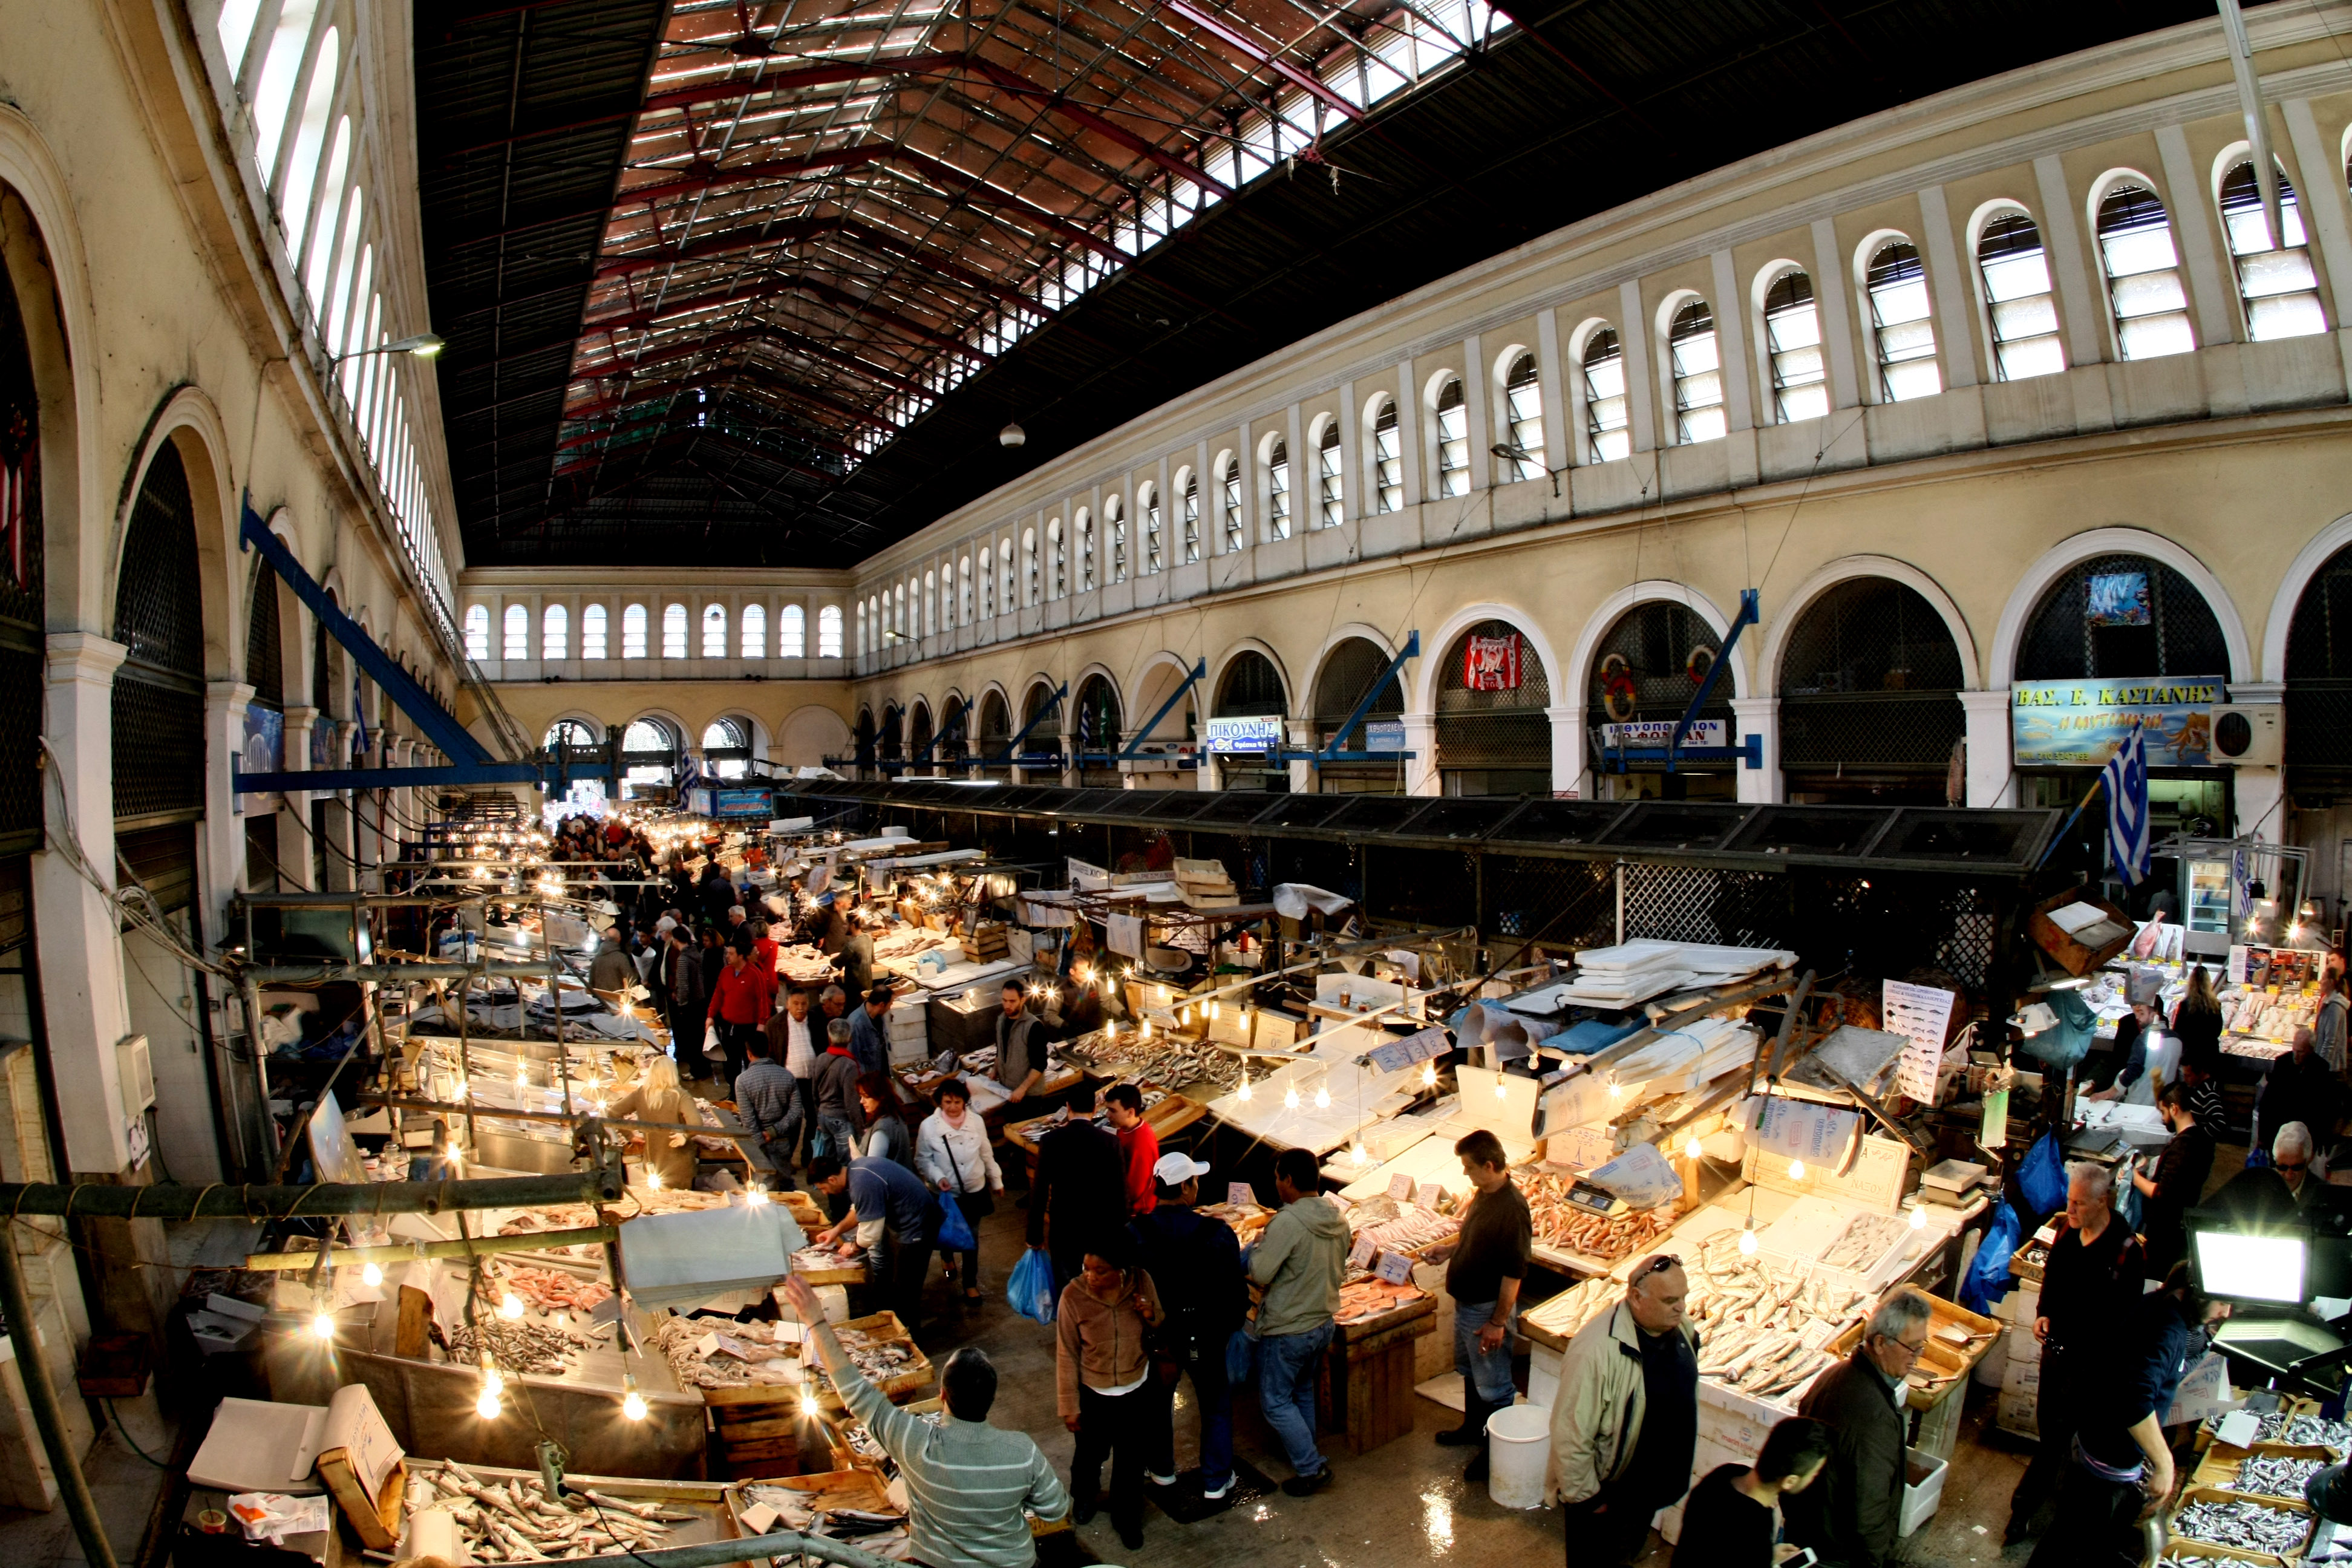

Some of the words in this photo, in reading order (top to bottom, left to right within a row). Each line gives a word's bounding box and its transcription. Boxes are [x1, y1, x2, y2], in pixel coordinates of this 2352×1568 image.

[2097, 684, 2216, 706] ΚΑΣΤΑΝΗΣ
[1210, 722, 1273, 737] ΠΙΚΟΥΝΗΣ
[1851, 1178, 1883, 1196] ΝΑΞΟΥ
